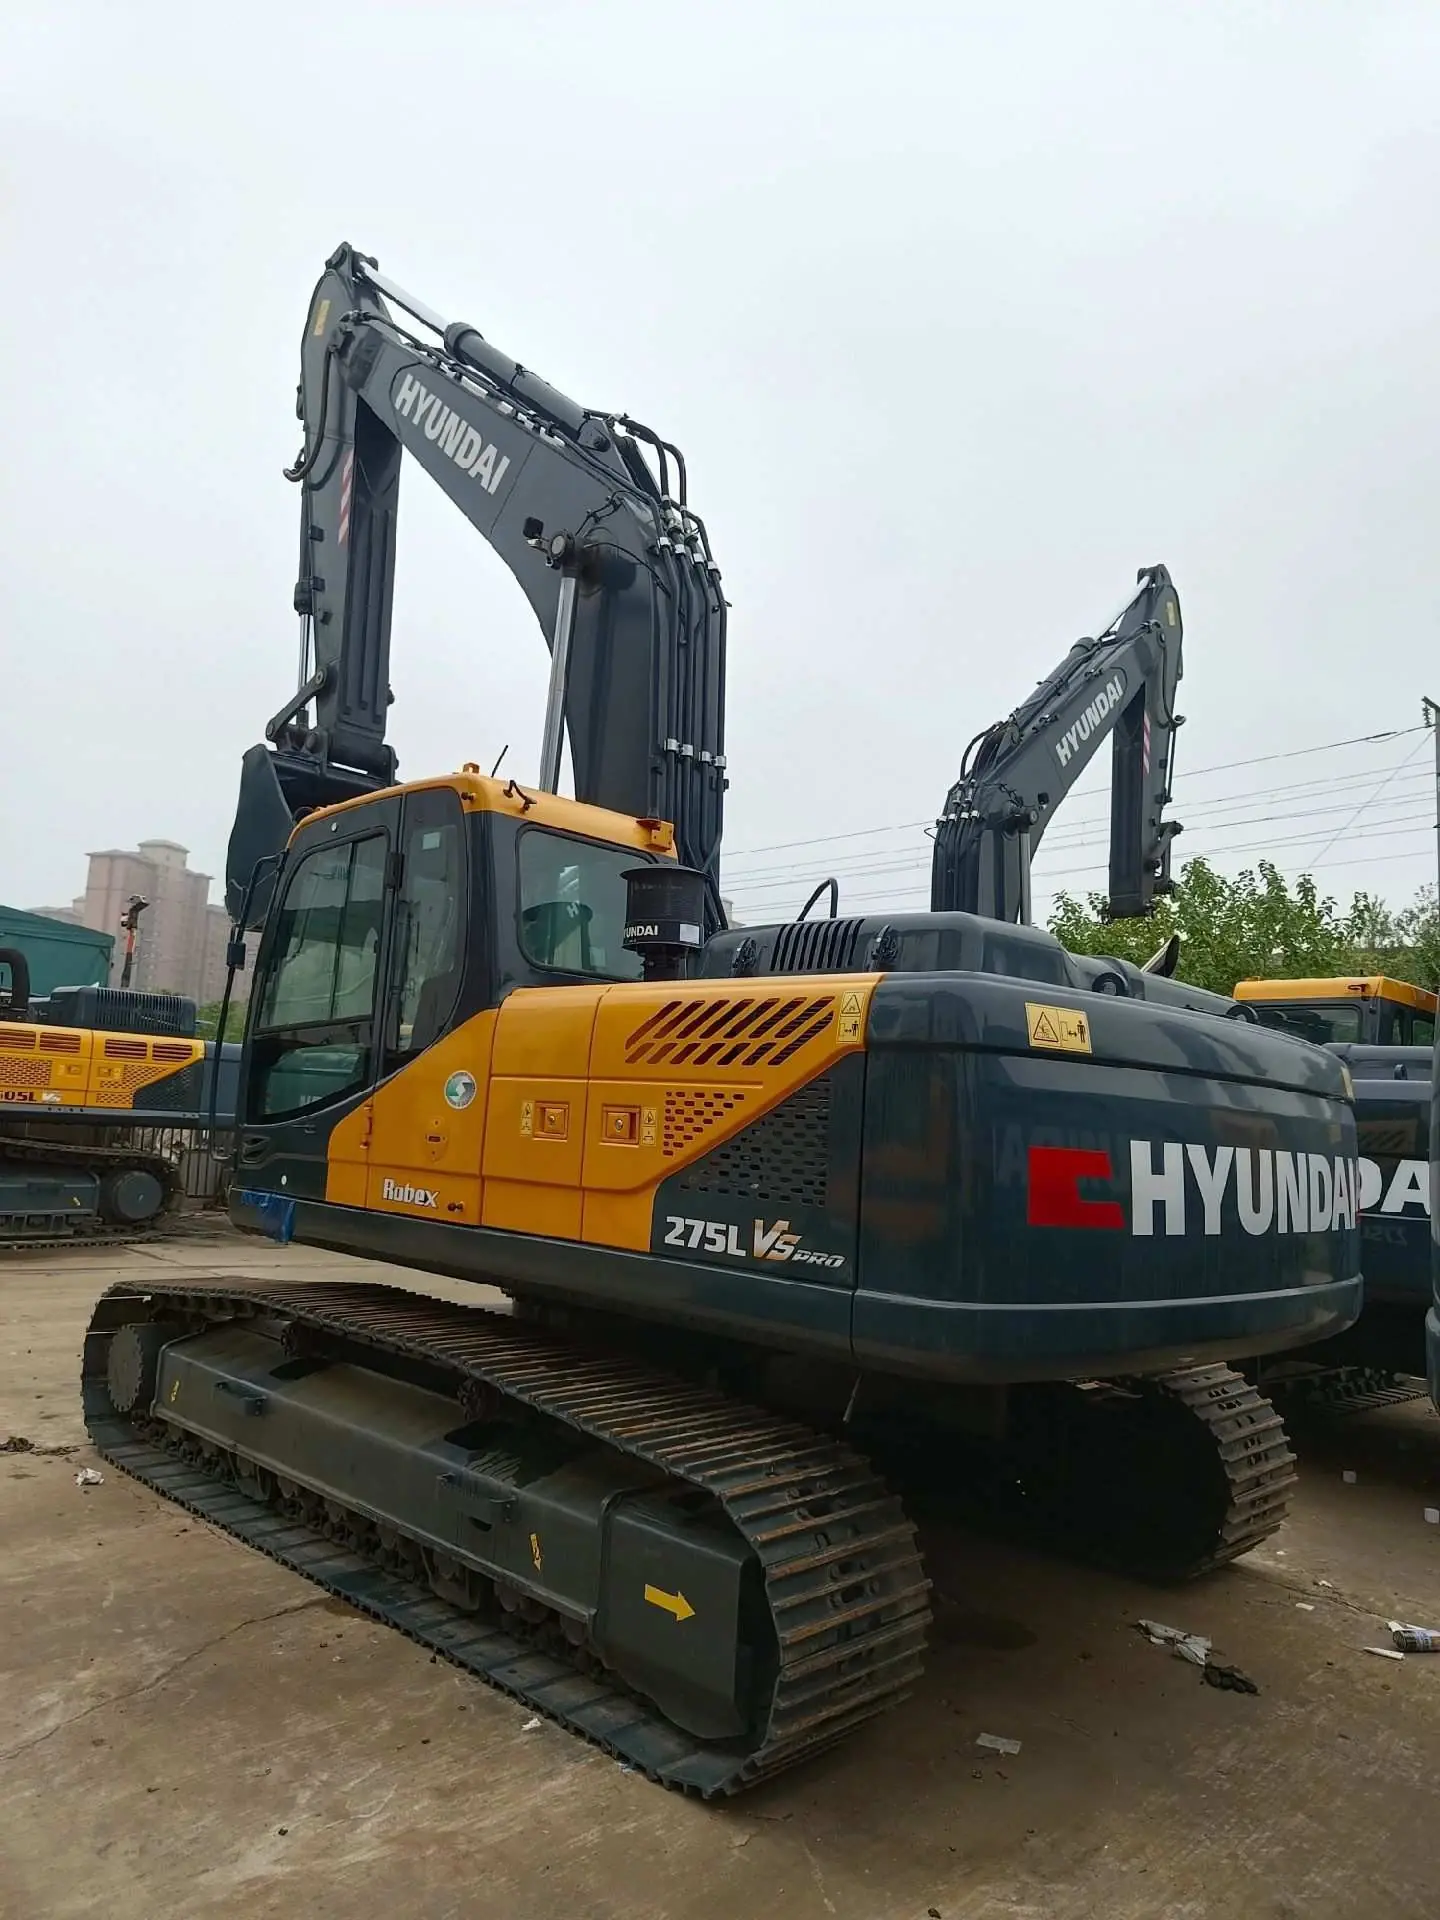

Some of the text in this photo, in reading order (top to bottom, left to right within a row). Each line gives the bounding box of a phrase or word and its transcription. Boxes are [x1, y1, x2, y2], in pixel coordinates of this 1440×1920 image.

[395, 373, 511, 496] HYUNDAI
[1055, 674, 1124, 768] HYUNDAI
[383, 1178, 440, 1208] Robex
[1130, 1139, 1357, 1236] HYUNDAI
[664, 1216, 747, 1257] 275L
[791, 1250, 847, 1269] PRO
